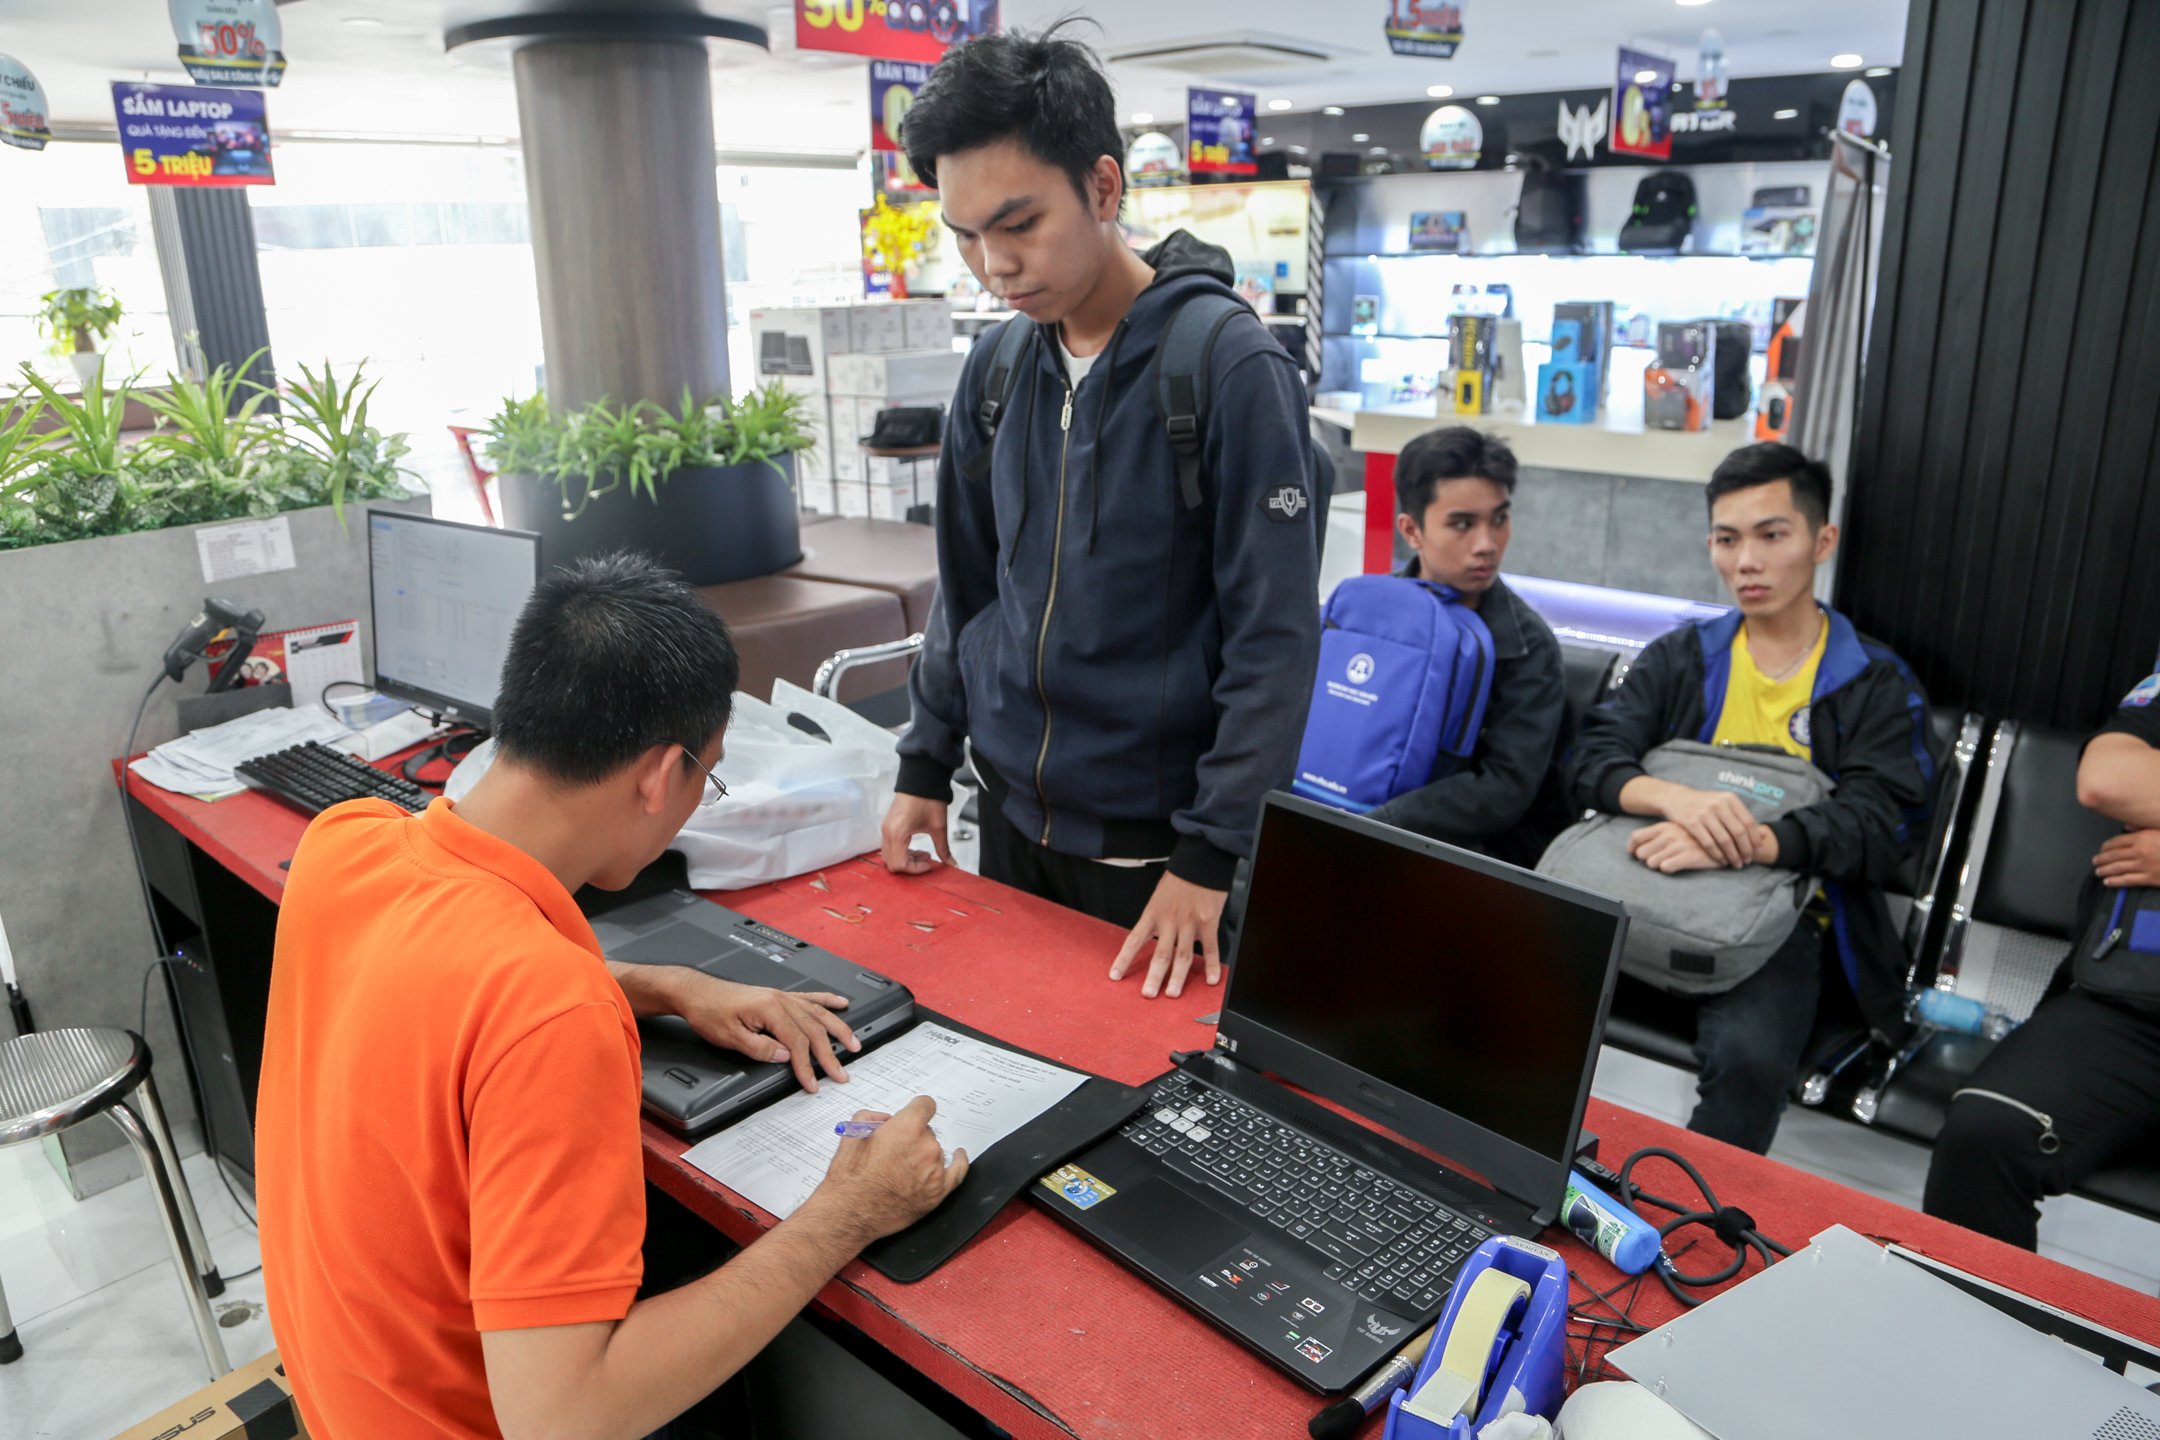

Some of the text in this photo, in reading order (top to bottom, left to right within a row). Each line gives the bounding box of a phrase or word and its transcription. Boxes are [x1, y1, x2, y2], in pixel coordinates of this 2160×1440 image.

[201, 24, 266, 56] 50%
[122, 92, 234, 119] SẮM LAPTOP
[127, 122, 207, 139] QUÀ TẶNG ĐẾN
[133, 148, 213, 181] 5 TRIỆU
[1718, 770, 1785, 800] thinkpro
[151, 1406, 216, 1440] SUS
